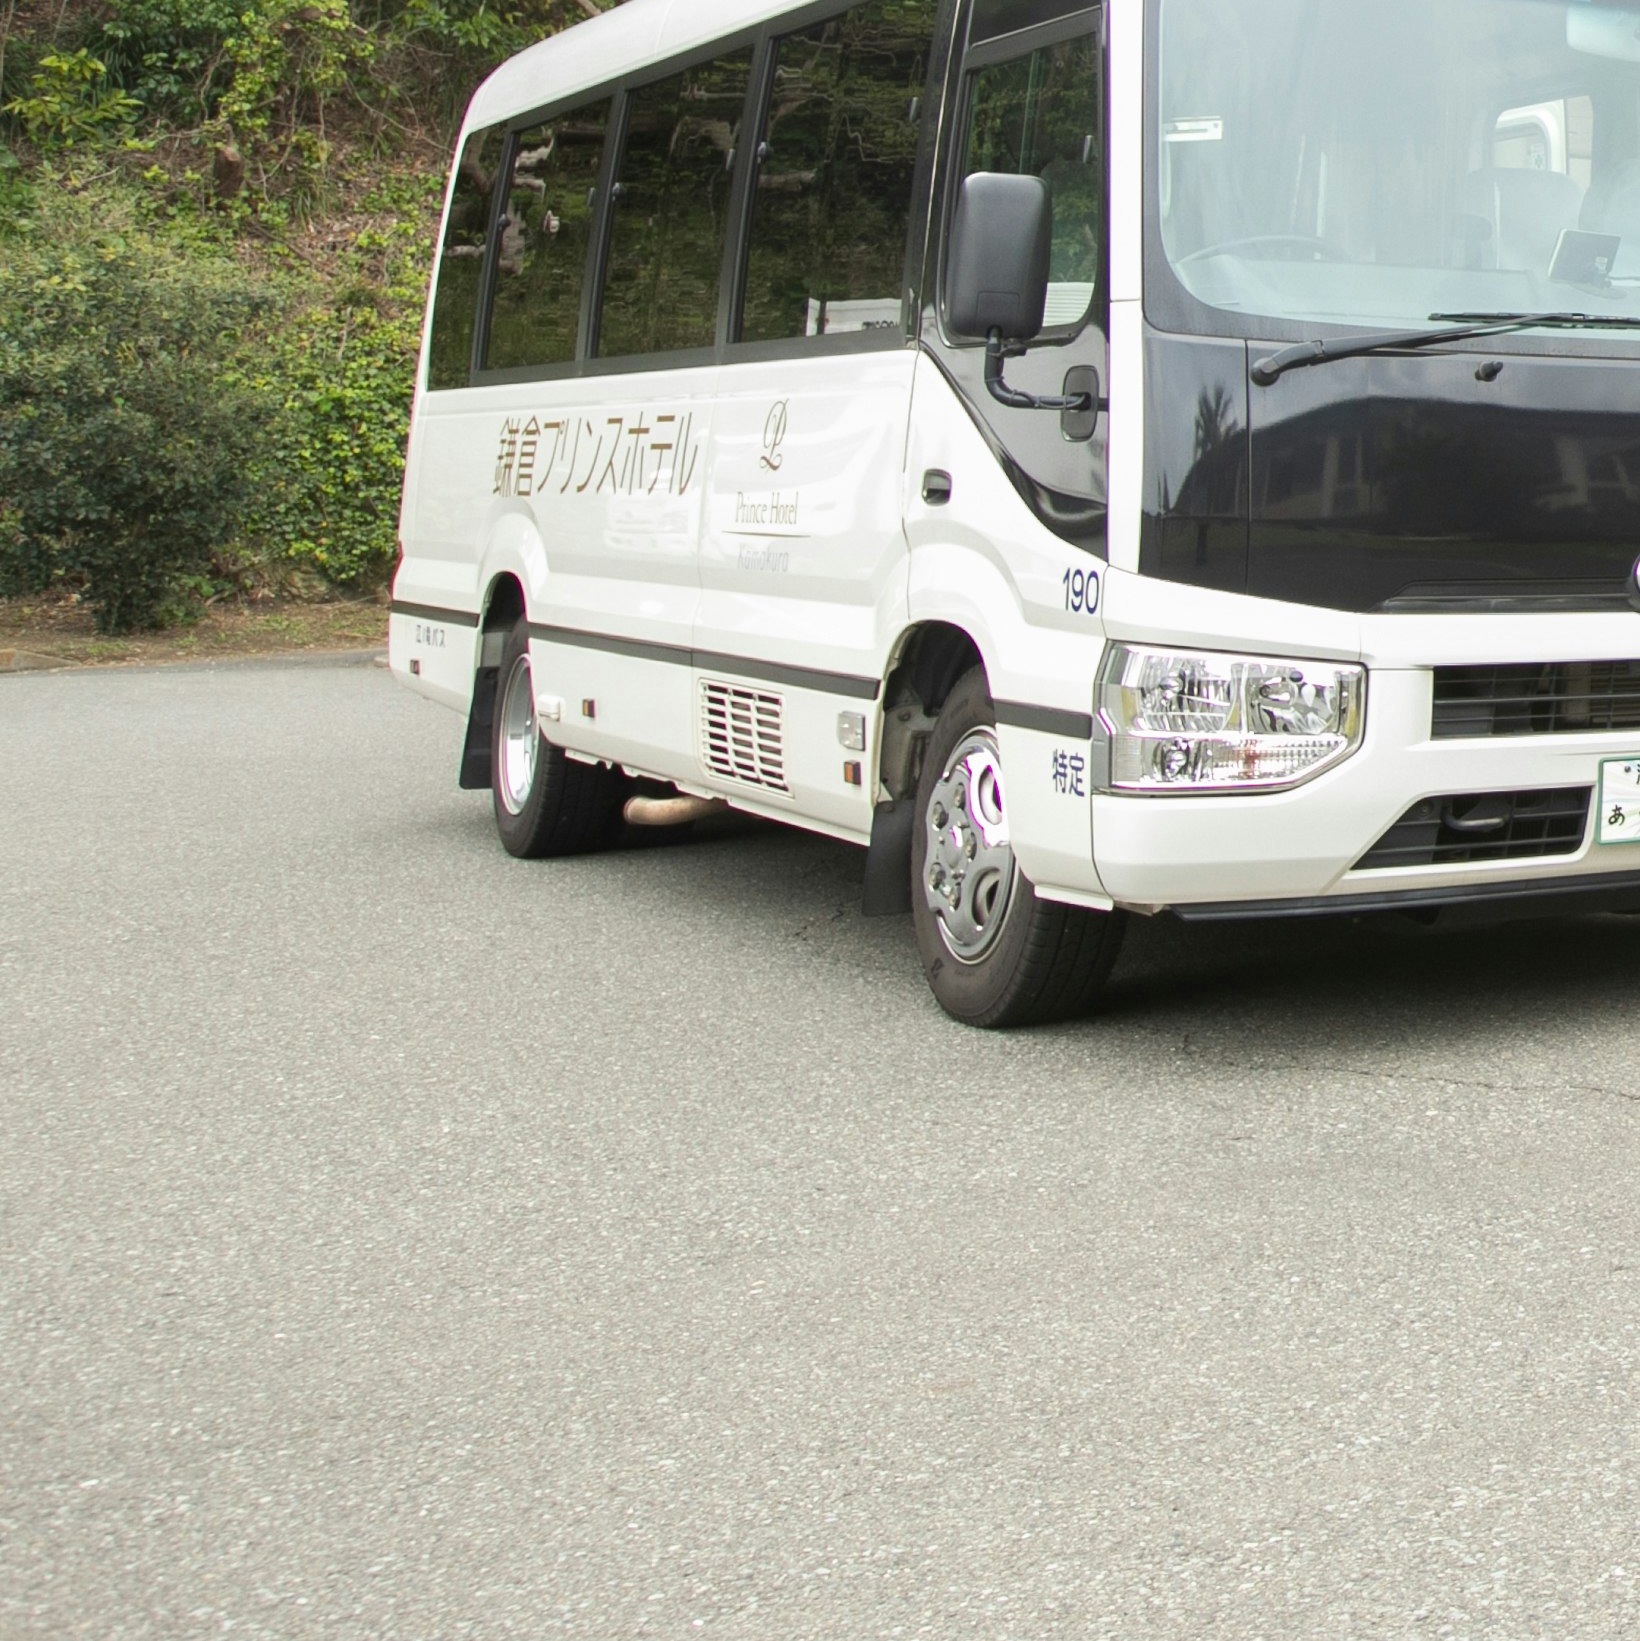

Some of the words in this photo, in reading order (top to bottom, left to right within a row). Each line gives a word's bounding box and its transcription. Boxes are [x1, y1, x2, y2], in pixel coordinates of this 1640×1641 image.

[493, 410, 698, 498] 鎌倉プリンスホテル
[735, 491, 768, 524] Prince
[770, 491, 799, 525] Hotel
[737, 543, 790, 573] Kamakura
[1063, 567, 1100, 615] 190
[1052, 748, 1085, 797] 特定
[1608, 804, 1625, 827] あ
